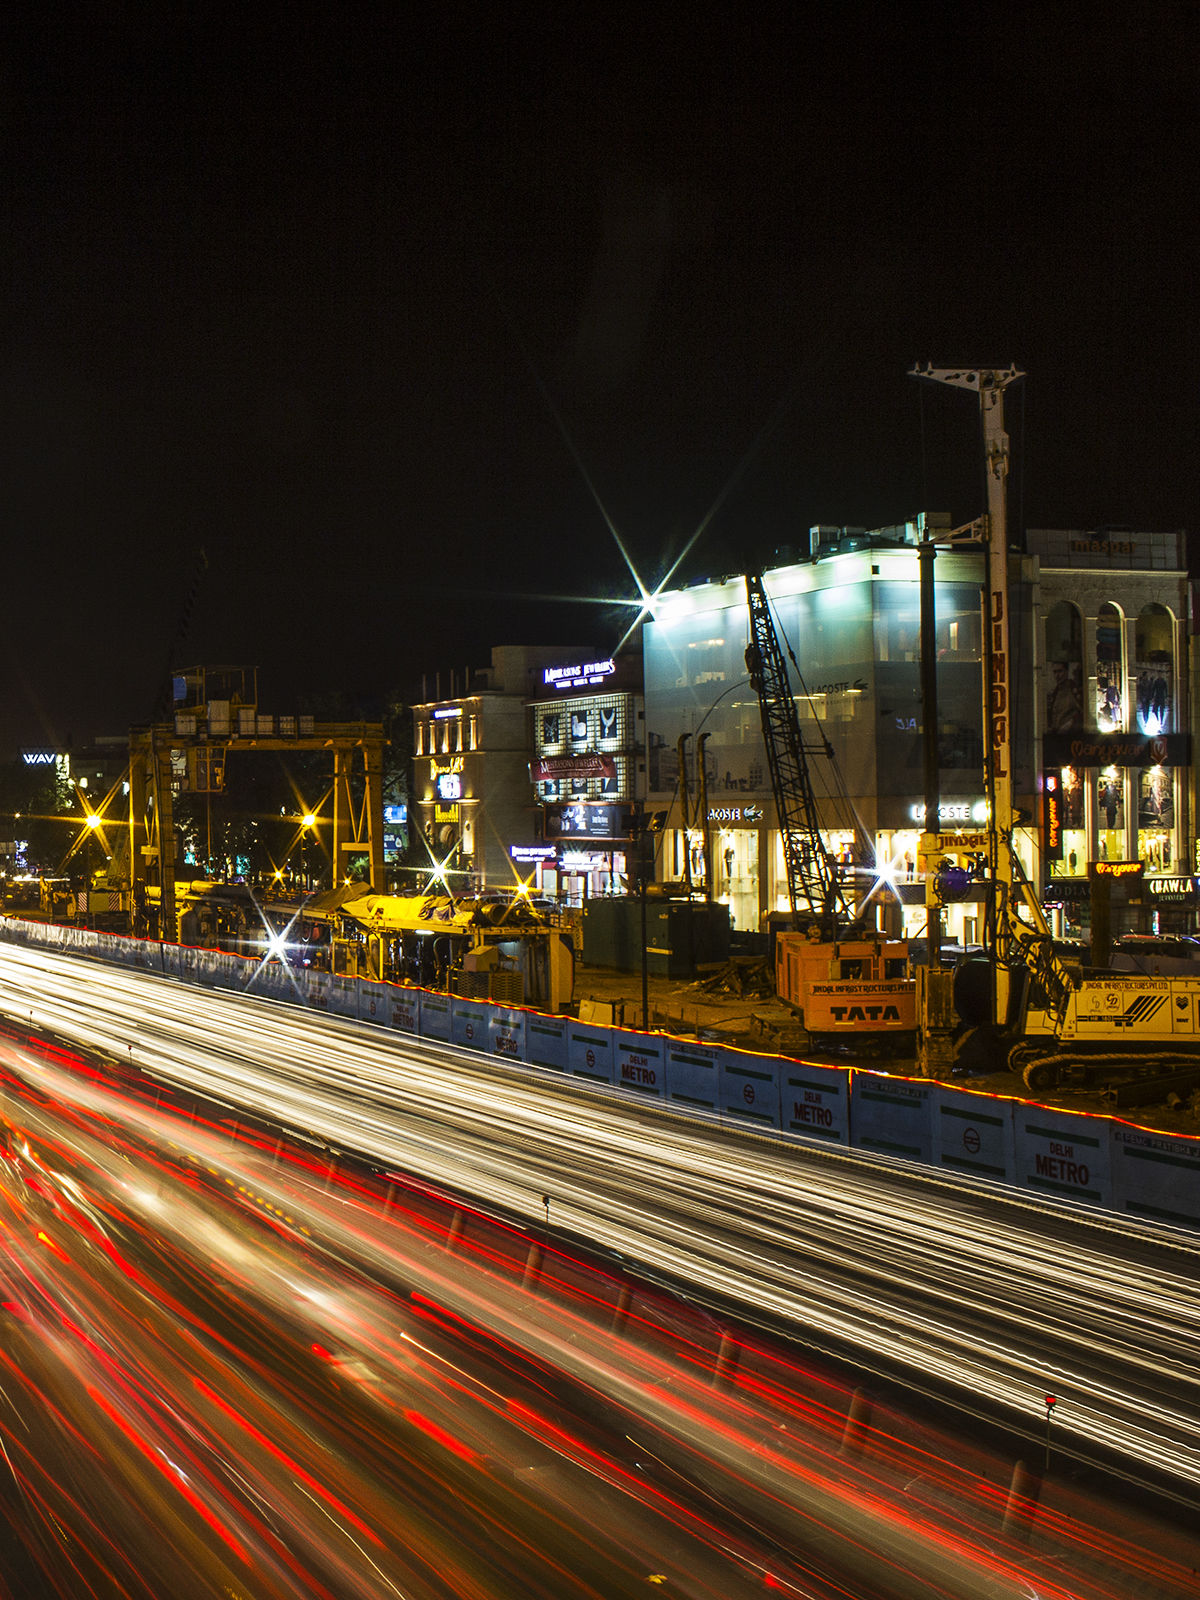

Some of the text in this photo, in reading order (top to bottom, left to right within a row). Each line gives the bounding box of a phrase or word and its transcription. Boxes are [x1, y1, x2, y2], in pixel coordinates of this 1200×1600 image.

[811, 682, 849, 694] LACOSTE
[23, 753, 56, 764] WAV
[706, 808, 741, 820] ACOSTE
[916, 807, 970, 818] LOSTE
[1150, 879, 1193, 894] CHAWLA
[830, 1006, 900, 1021] TATA
[629, 1054, 649, 1067] DELHI
[621, 1064, 656, 1085] METRO
[804, 1090, 822, 1104] DELHI
[794, 1102, 832, 1127] METRO
[1050, 1142, 1073, 1158] DELHI
[1035, 1153, 1089, 1186] METRO
